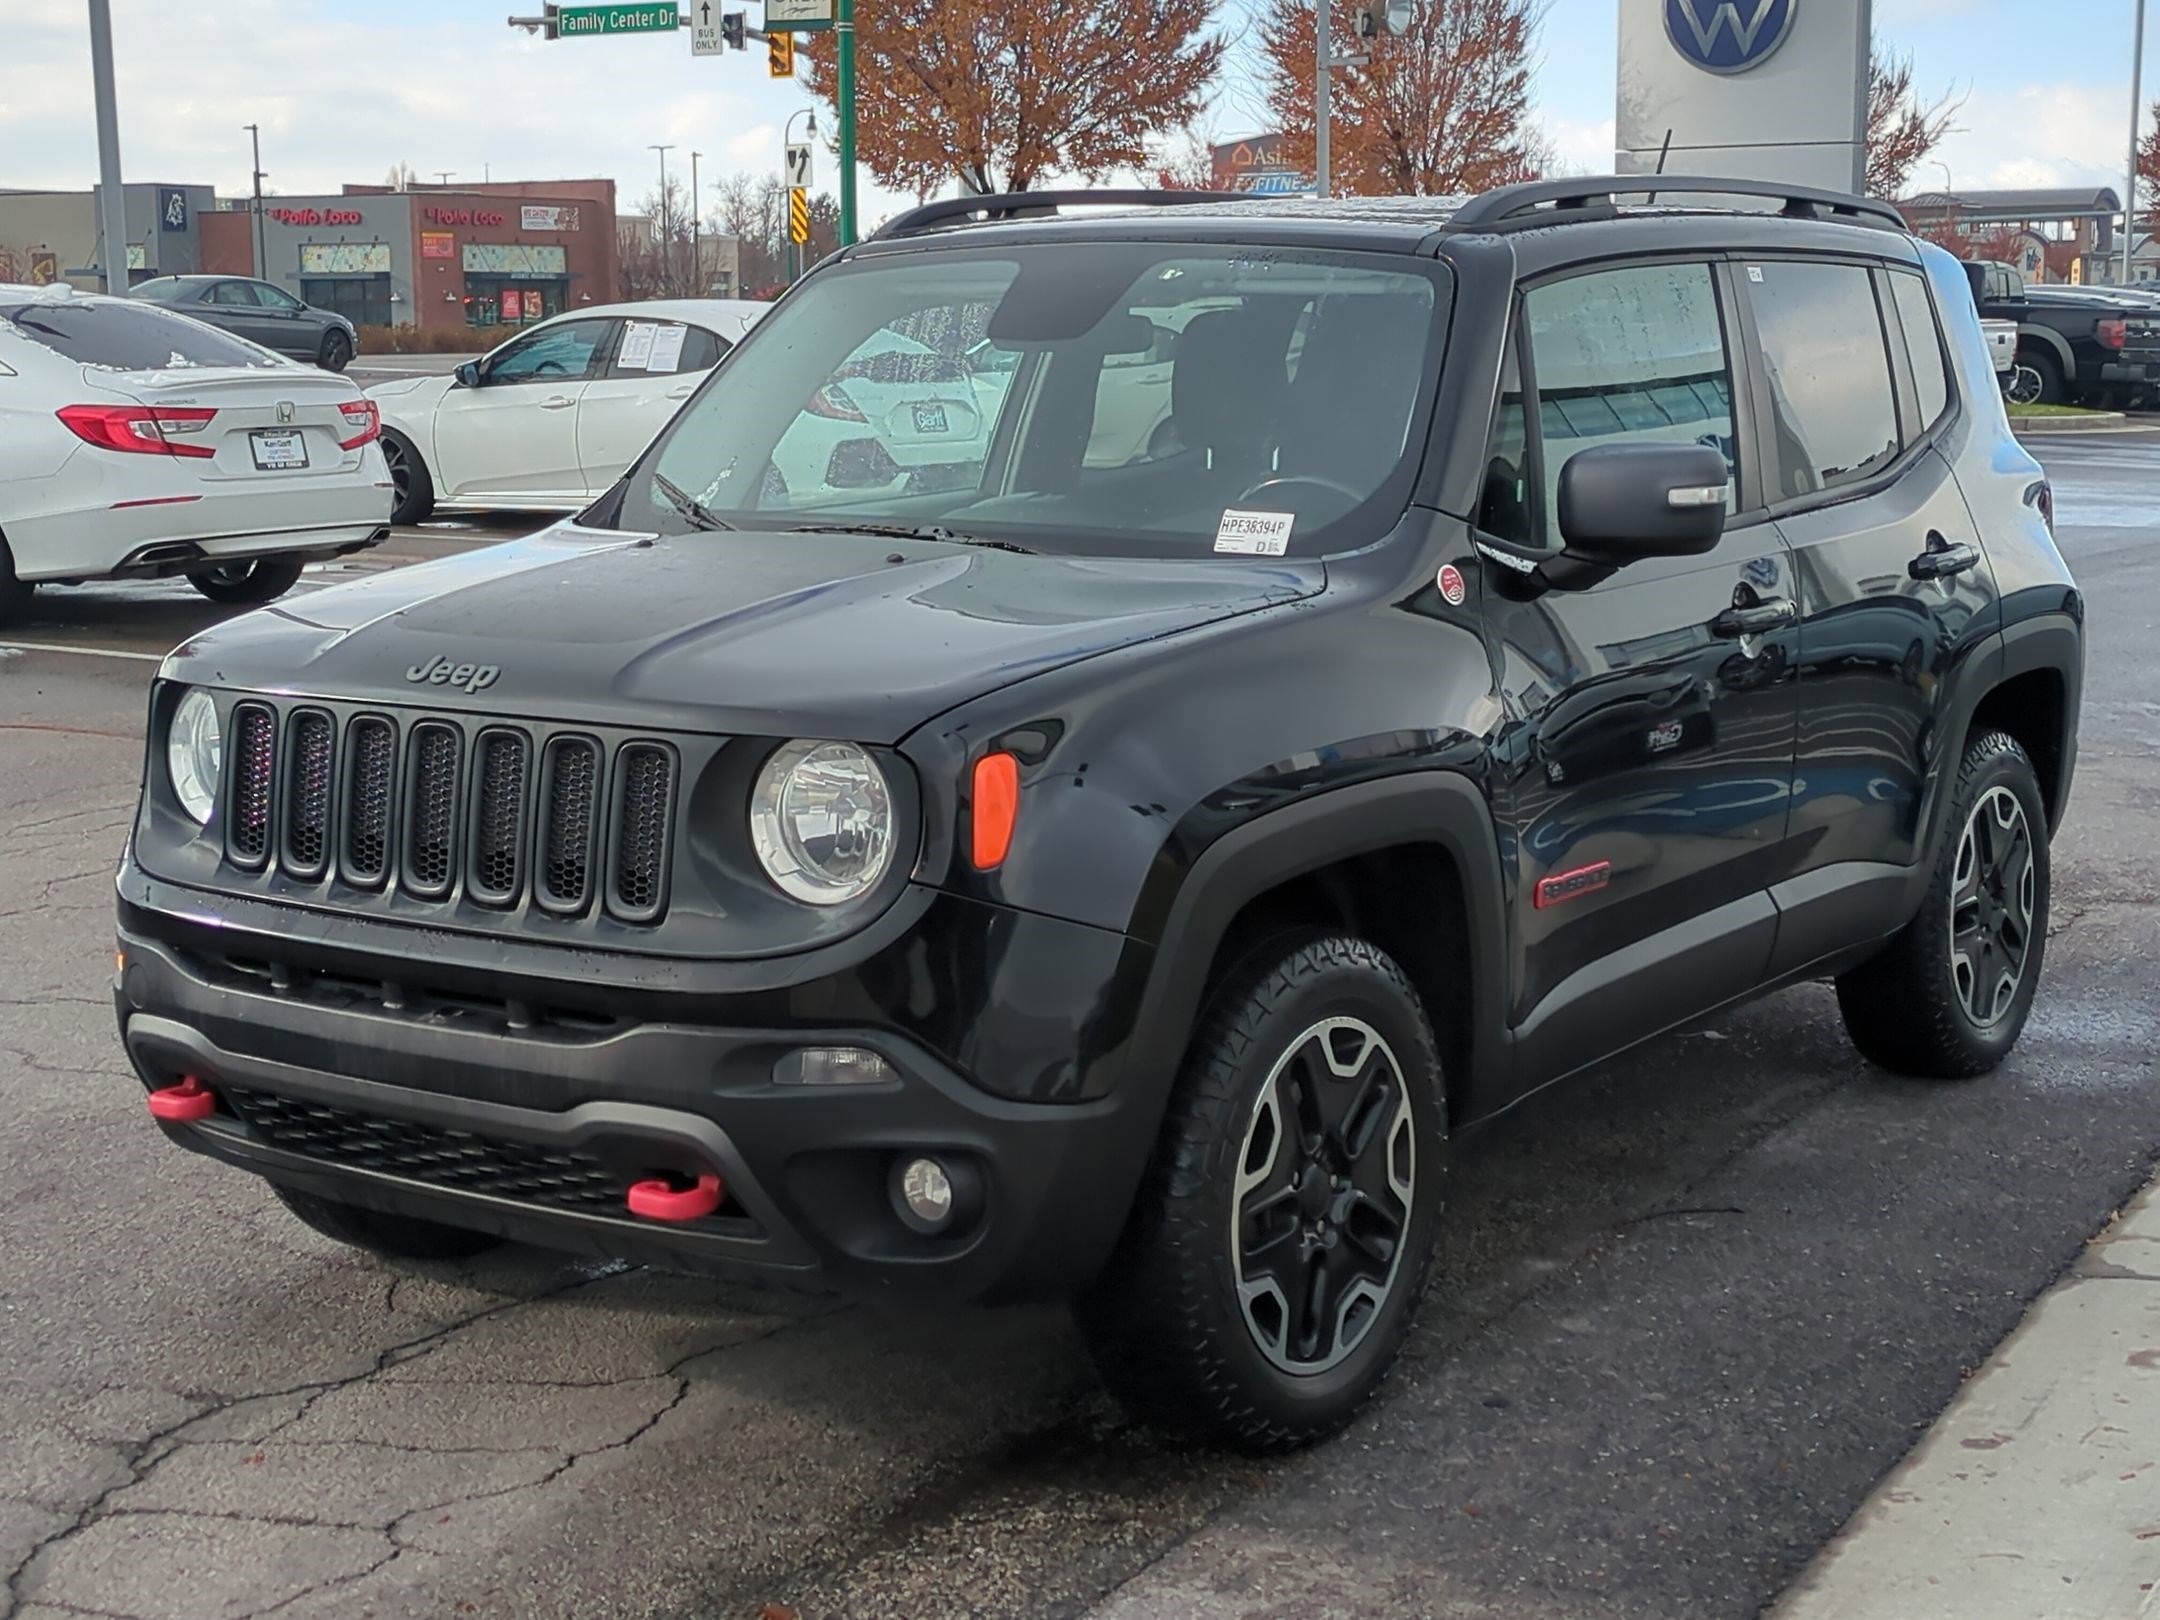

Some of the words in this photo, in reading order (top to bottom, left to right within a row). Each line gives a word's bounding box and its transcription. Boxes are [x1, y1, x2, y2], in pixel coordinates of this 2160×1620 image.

[561, 12, 605, 32] Family
[610, 11, 655, 28] Center
[659, 9, 675, 26] Dr
[698, 29, 715, 38] BUS
[696, 40, 718, 50] ONLY
[281, 208, 319, 225] Pollo
[322, 208, 361, 226] Loco
[437, 208, 468, 224] Pollo
[473, 210, 503, 225] Loco
[1255, 541, 1266, 553] D
[405, 654, 500, 694] Jeep
